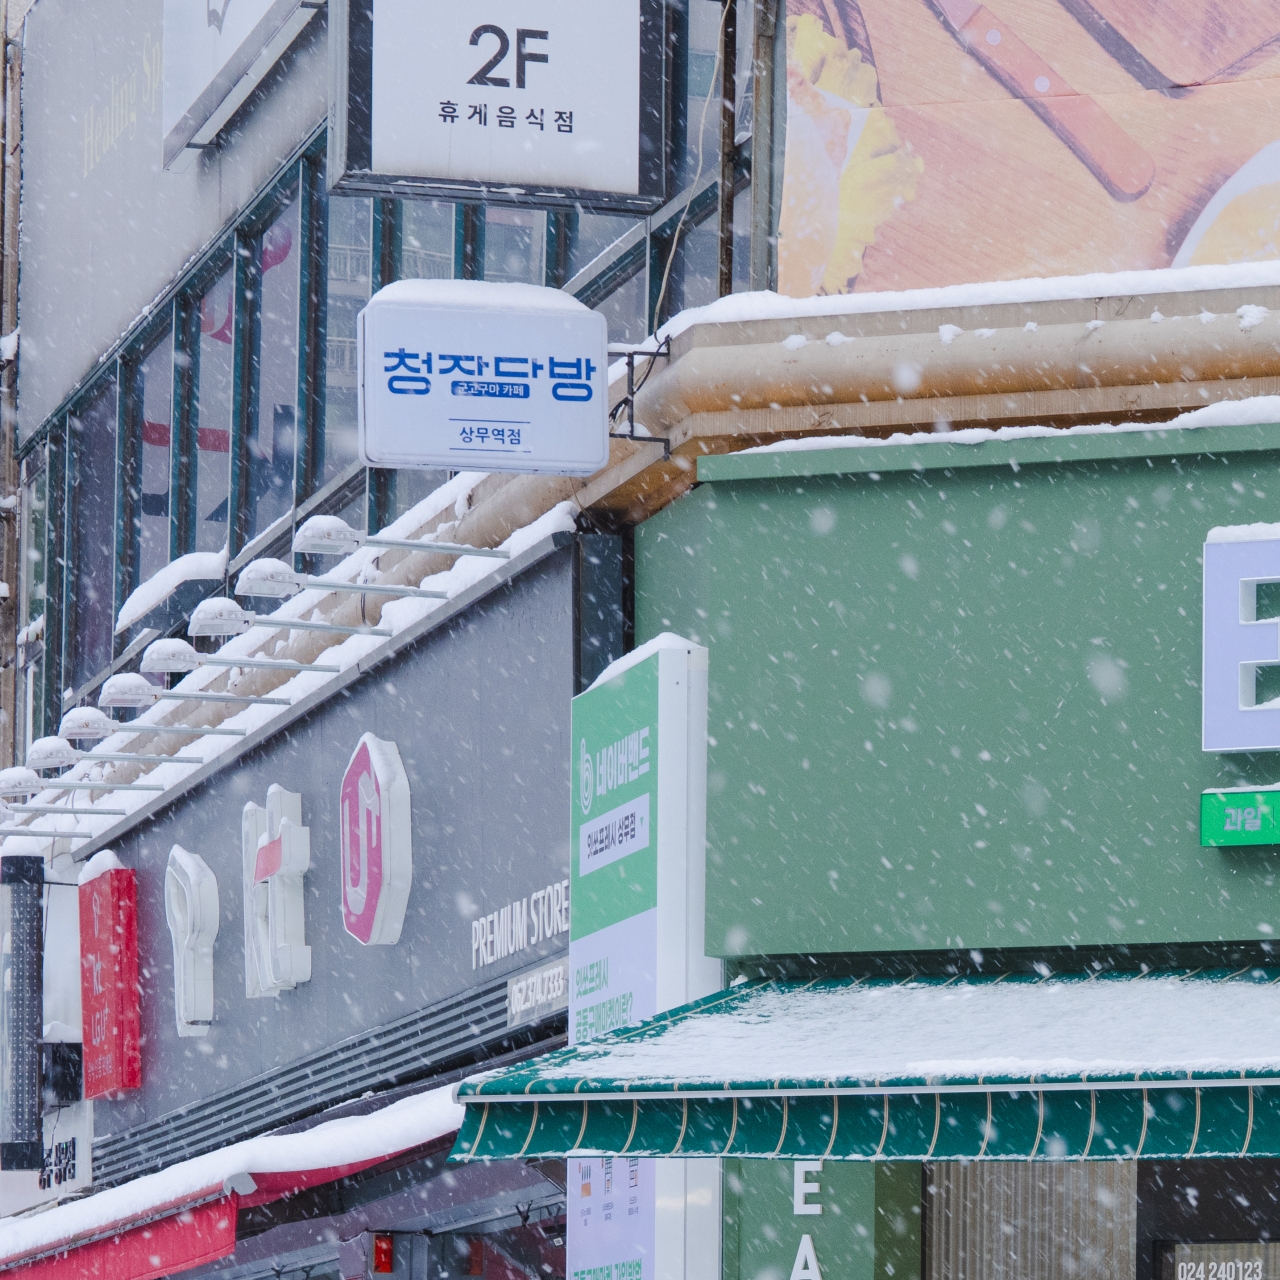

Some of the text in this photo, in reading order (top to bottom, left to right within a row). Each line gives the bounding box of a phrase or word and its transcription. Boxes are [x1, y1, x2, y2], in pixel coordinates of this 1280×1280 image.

[467, 24, 550, 89] 2F
[437, 99, 574, 134] 휴게음식점
[458, 382, 524, 397] 군고구마 카페
[459, 427, 521, 445] 상무역점
[597, 726, 650, 796] 네이버밴드
[617, 810, 637, 844] 상무점
[1224, 807, 1262, 831] 과일
[472, 878, 570, 971] PREMIUM STORE
[575, 957, 609, 999] 잇쏘프레시
